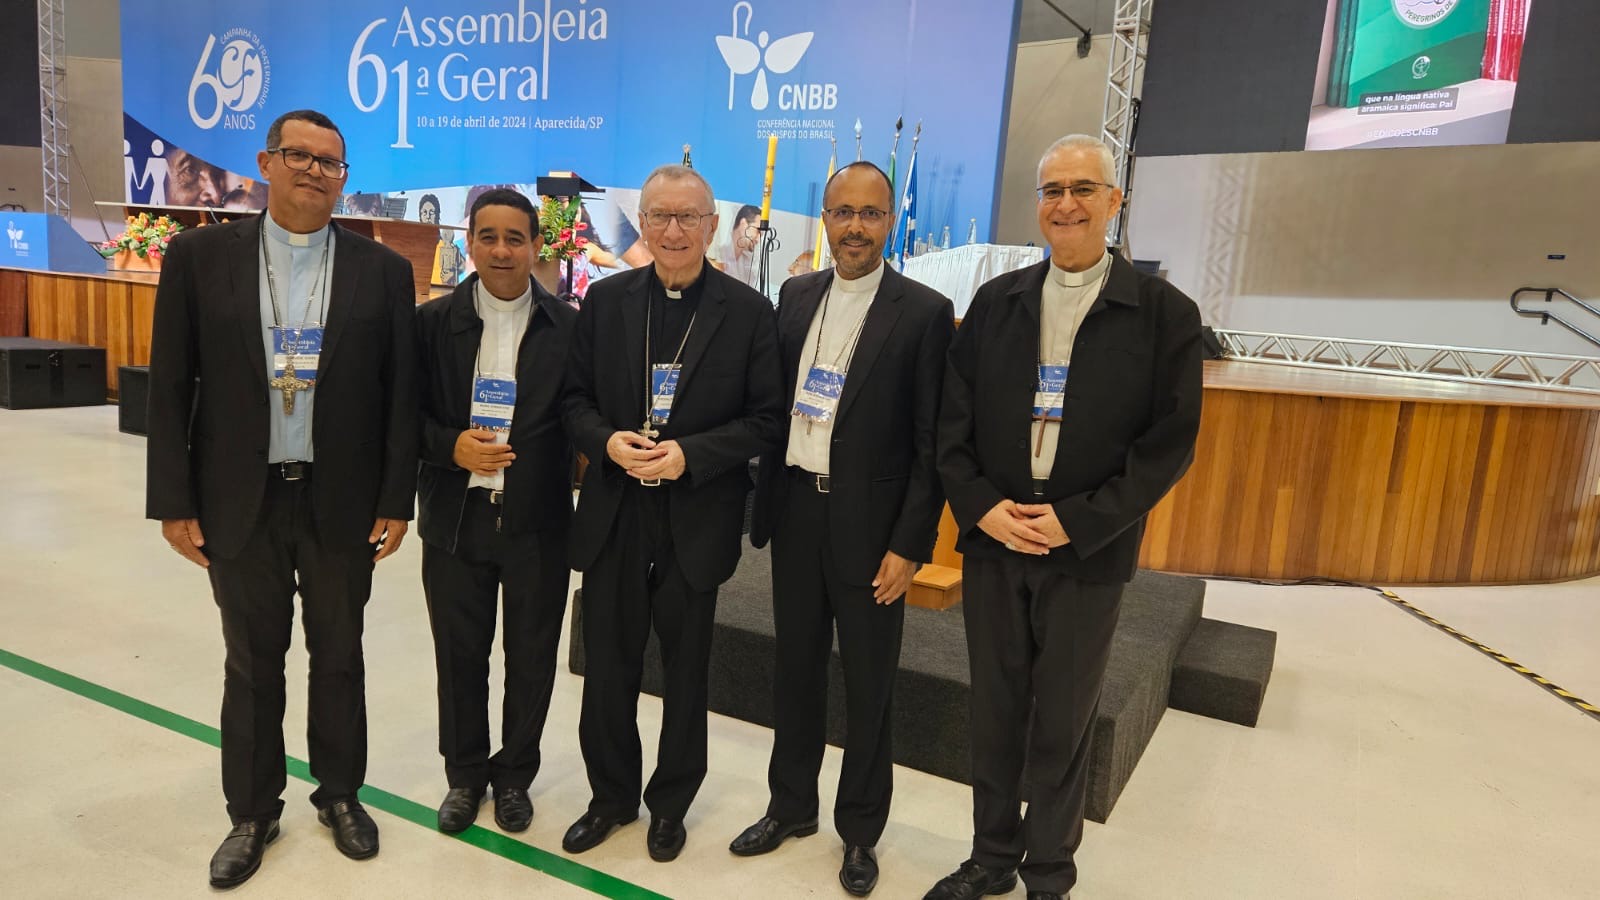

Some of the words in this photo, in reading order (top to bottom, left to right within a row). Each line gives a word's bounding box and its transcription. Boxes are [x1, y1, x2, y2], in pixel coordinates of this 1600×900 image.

[392, 0, 608, 48] Assembleia
[437, 52, 549, 101] Geral
[778, 83, 838, 111] CNBB
[1365, 95, 1381, 104] que
[1423, 91, 1450, 100] nativa
[1361, 104, 1398, 112] aramaica
[1439, 100, 1453, 108] Pai
[223, 114, 256, 130] ANOS
[417, 116, 427, 128] 10
[429, 119, 435, 128] a
[438, 116, 448, 128] 19
[450, 116, 461, 128] de
[464, 116, 486, 128] abril
[488, 116, 500, 128] de
[502, 116, 526, 128] 2024
[534, 116, 604, 130] Aparecida/SP
[803, 119, 835, 129] NACIONAL
[757, 130, 770, 139] DOS
[799, 130, 808, 139] DO
[810, 130, 833, 139] BRASIL
